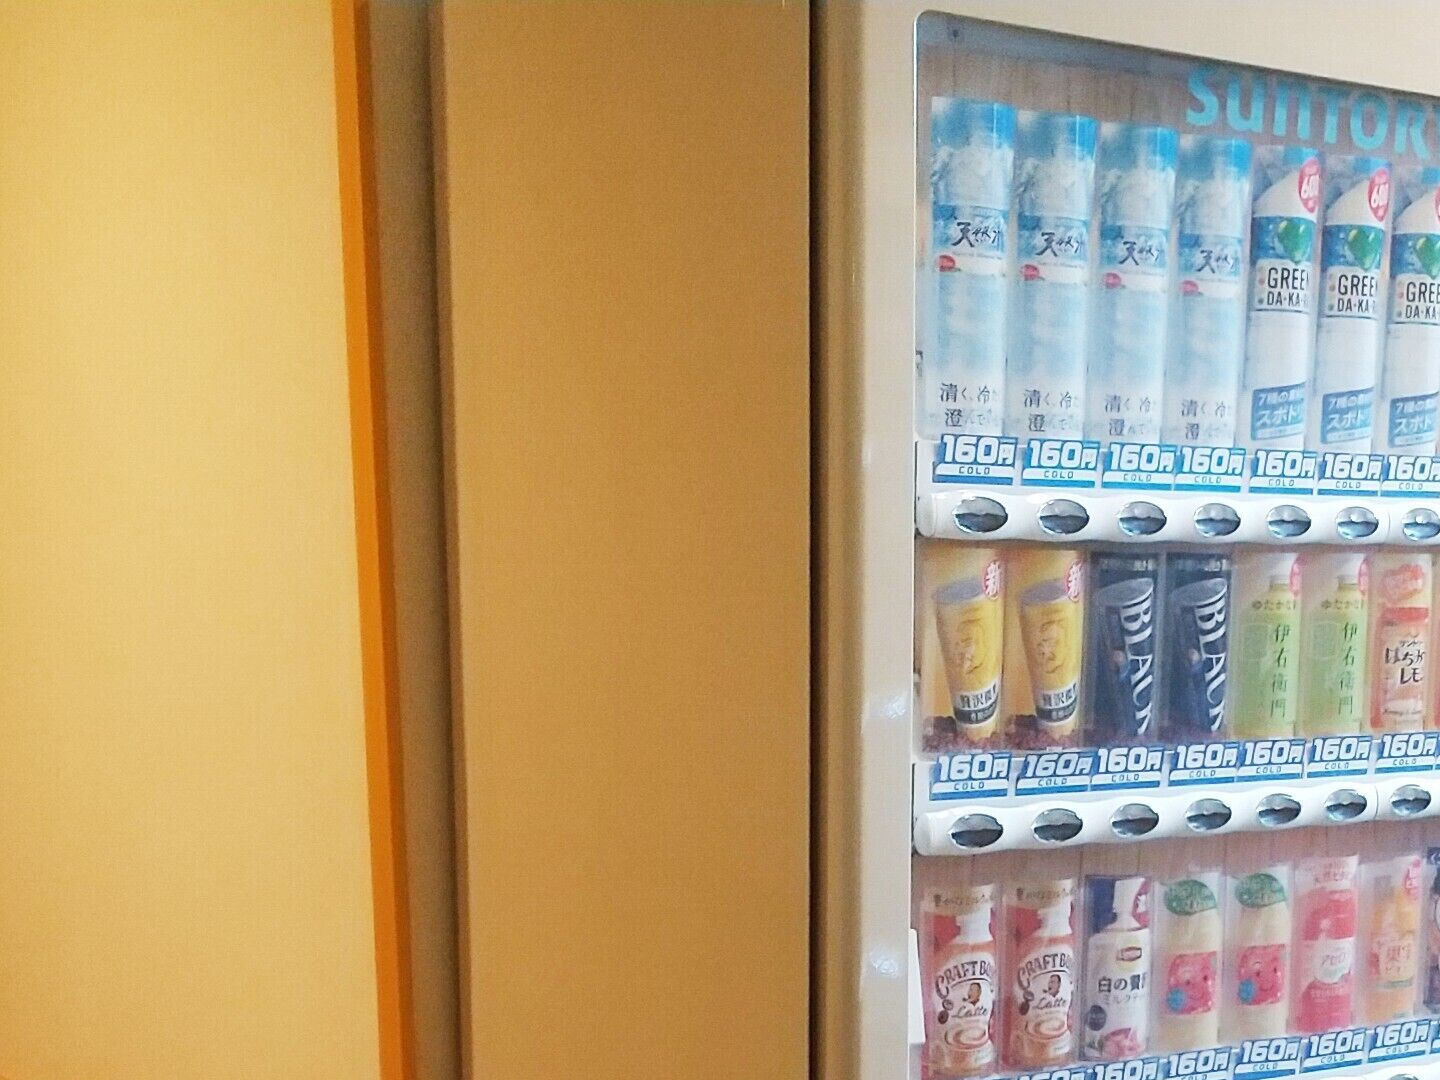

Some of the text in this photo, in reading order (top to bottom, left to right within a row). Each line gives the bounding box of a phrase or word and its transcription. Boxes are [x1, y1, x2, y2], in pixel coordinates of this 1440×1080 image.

[958, 466, 991, 475] COLD
[1043, 470, 1074, 479] COLD
[1123, 473, 1152, 482] COLD
[1194, 475, 1222, 484] COLD
[1268, 478, 1295, 487] COLD
[1335, 480, 1362, 489] COLD
[1398, 482, 1424, 490] COLD
[1324, 761, 1350, 770] COLD
[1392, 758, 1417, 766] COLD
[1189, 769, 1216, 778] COLD
[1256, 766, 1282, 774] COLD
[1037, 777, 1068, 787] COLD
[1111, 773, 1140, 782] COLD
[954, 781, 985, 791] COLD
[1320, 1053, 1345, 1064] COLD
[1252, 1062, 1278, 1071] COLD
